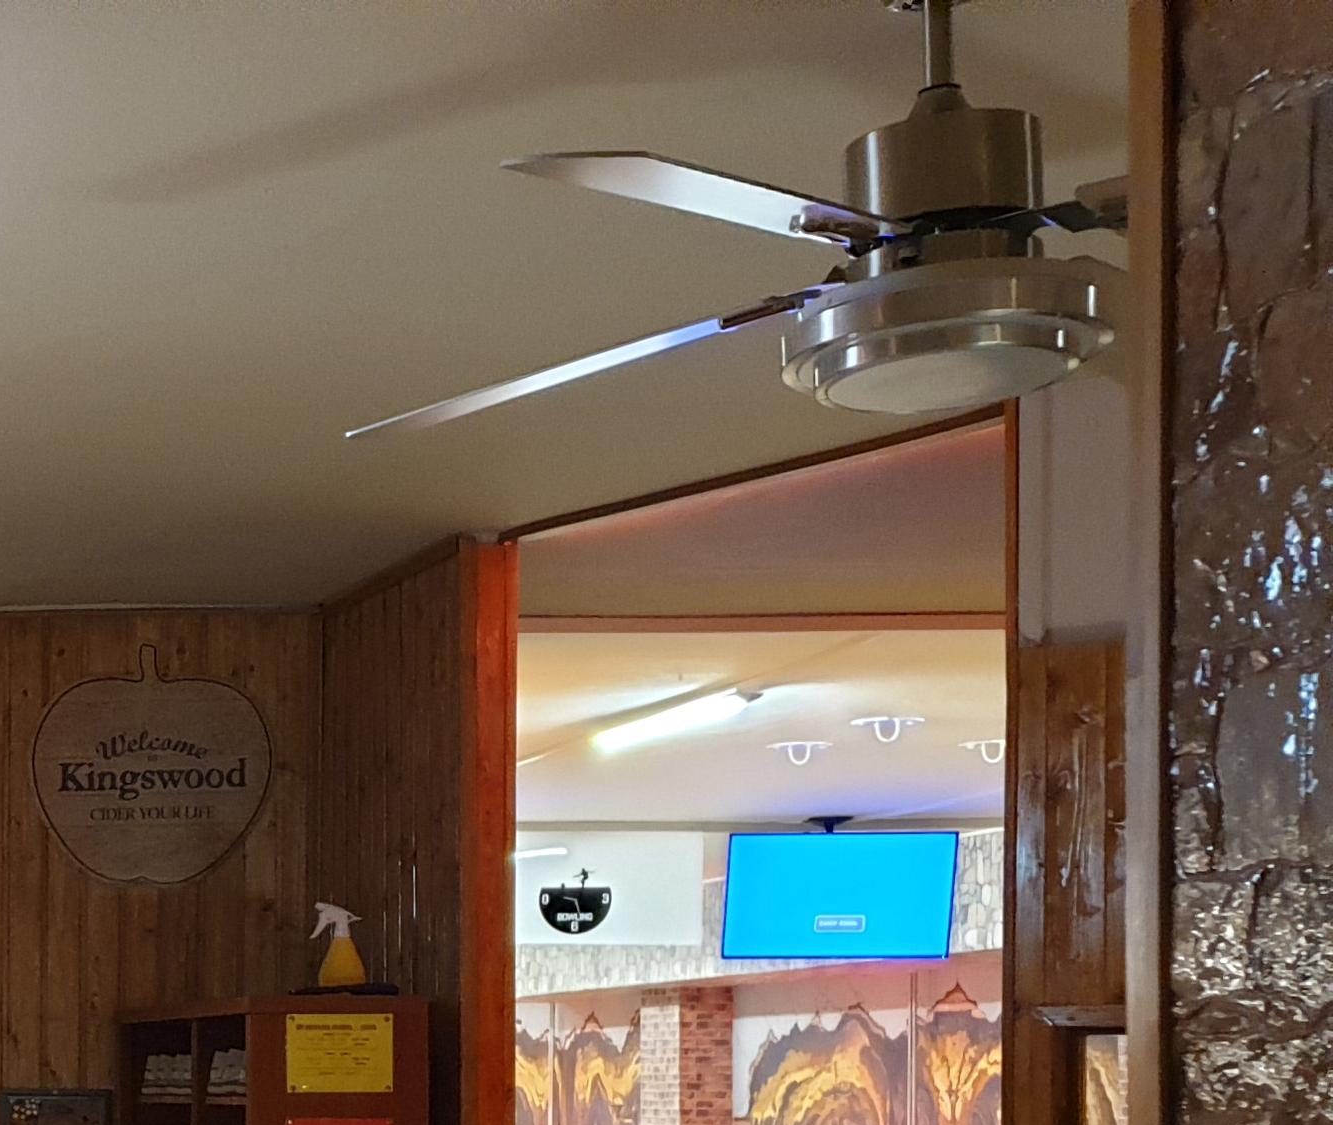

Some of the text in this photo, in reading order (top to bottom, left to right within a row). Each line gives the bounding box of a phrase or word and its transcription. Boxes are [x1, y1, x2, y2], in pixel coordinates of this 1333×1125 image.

[95, 729, 210, 761] Welcome
[57, 757, 248, 801] Kingswood
[89, 804, 216, 822] CIDER YOUR LIFE
